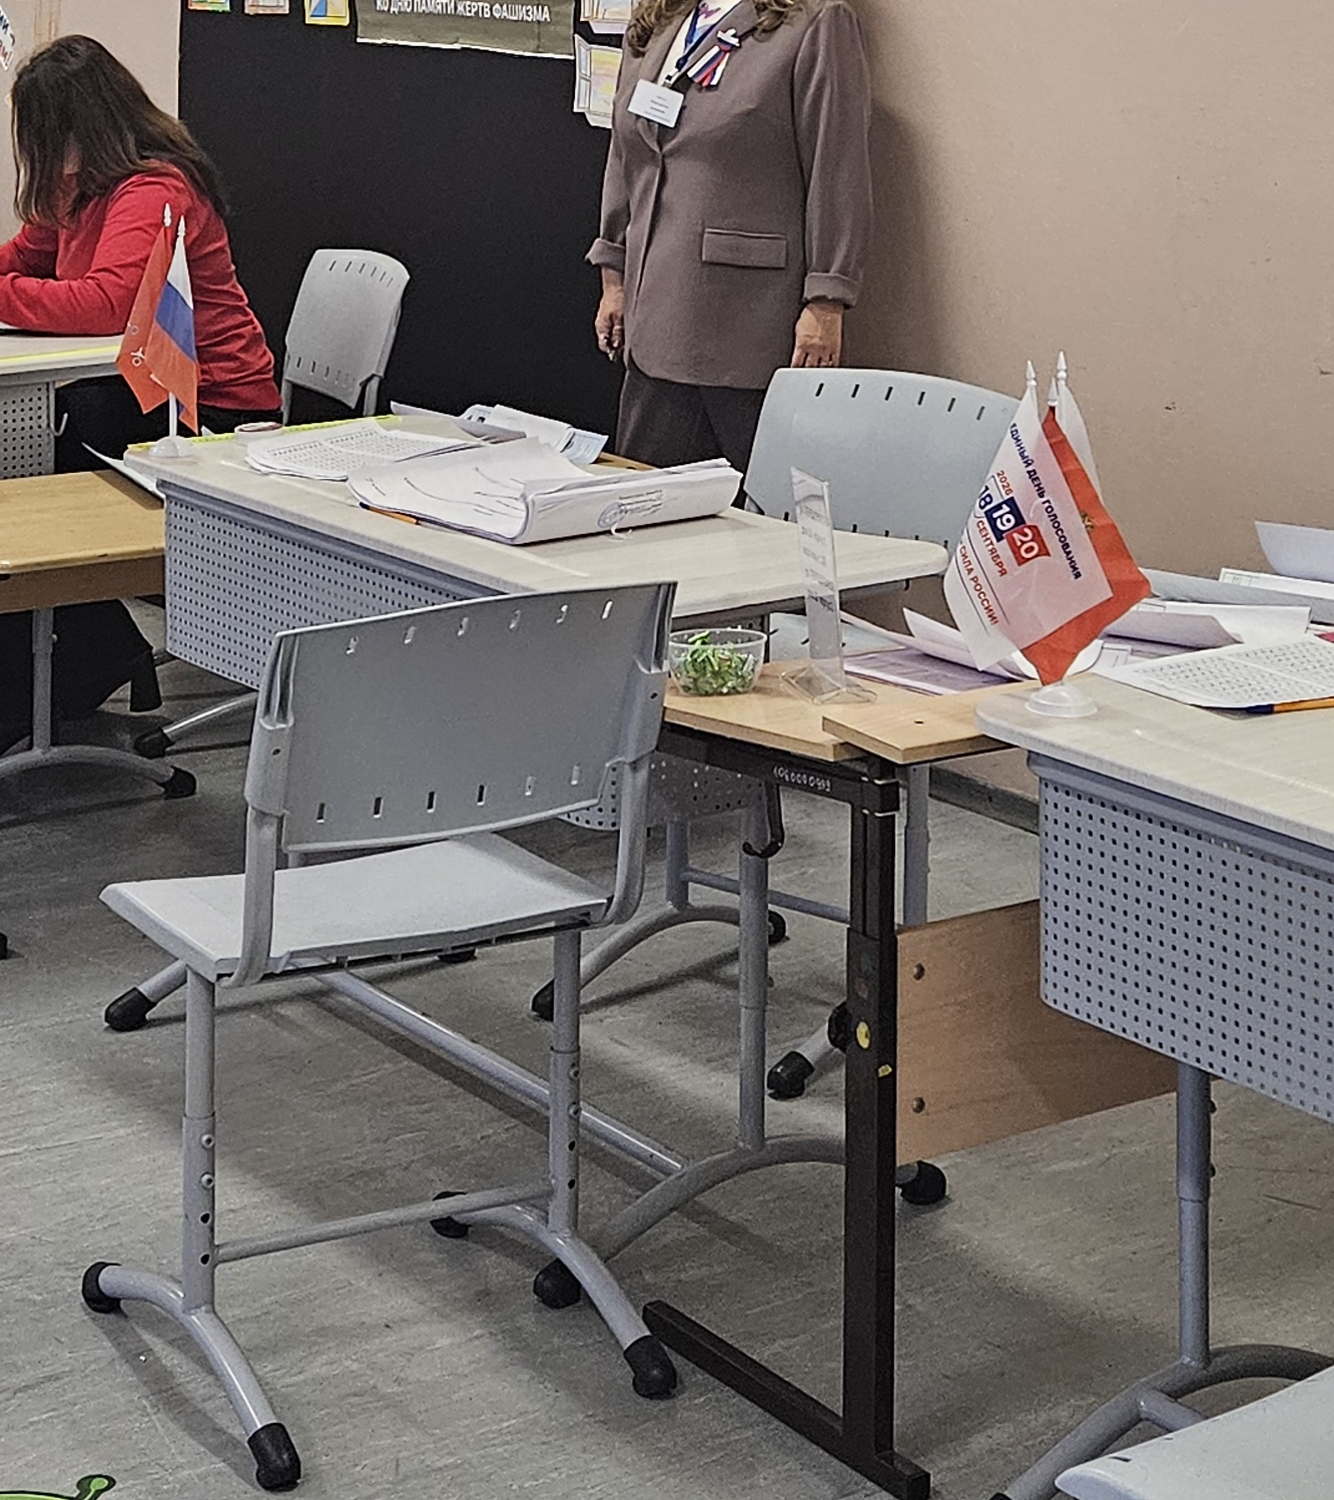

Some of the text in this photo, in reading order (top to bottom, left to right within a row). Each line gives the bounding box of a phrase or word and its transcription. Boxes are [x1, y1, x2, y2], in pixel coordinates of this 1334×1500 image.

[456, 0, 491, 18] ЖЕРТВ
[493, 4, 551, 22] ФАШИЗМА
[976, 520, 1007, 577] СЕНТЯБРЯ
[978, 485, 1038, 559] 18 19 20
[1026, 468, 1045, 500] ДЕНЬ
[1042, 499, 1082, 580] ГОЛОСОВАНИЯ
[960, 545, 999, 626] СИЛА РОССИИ!
